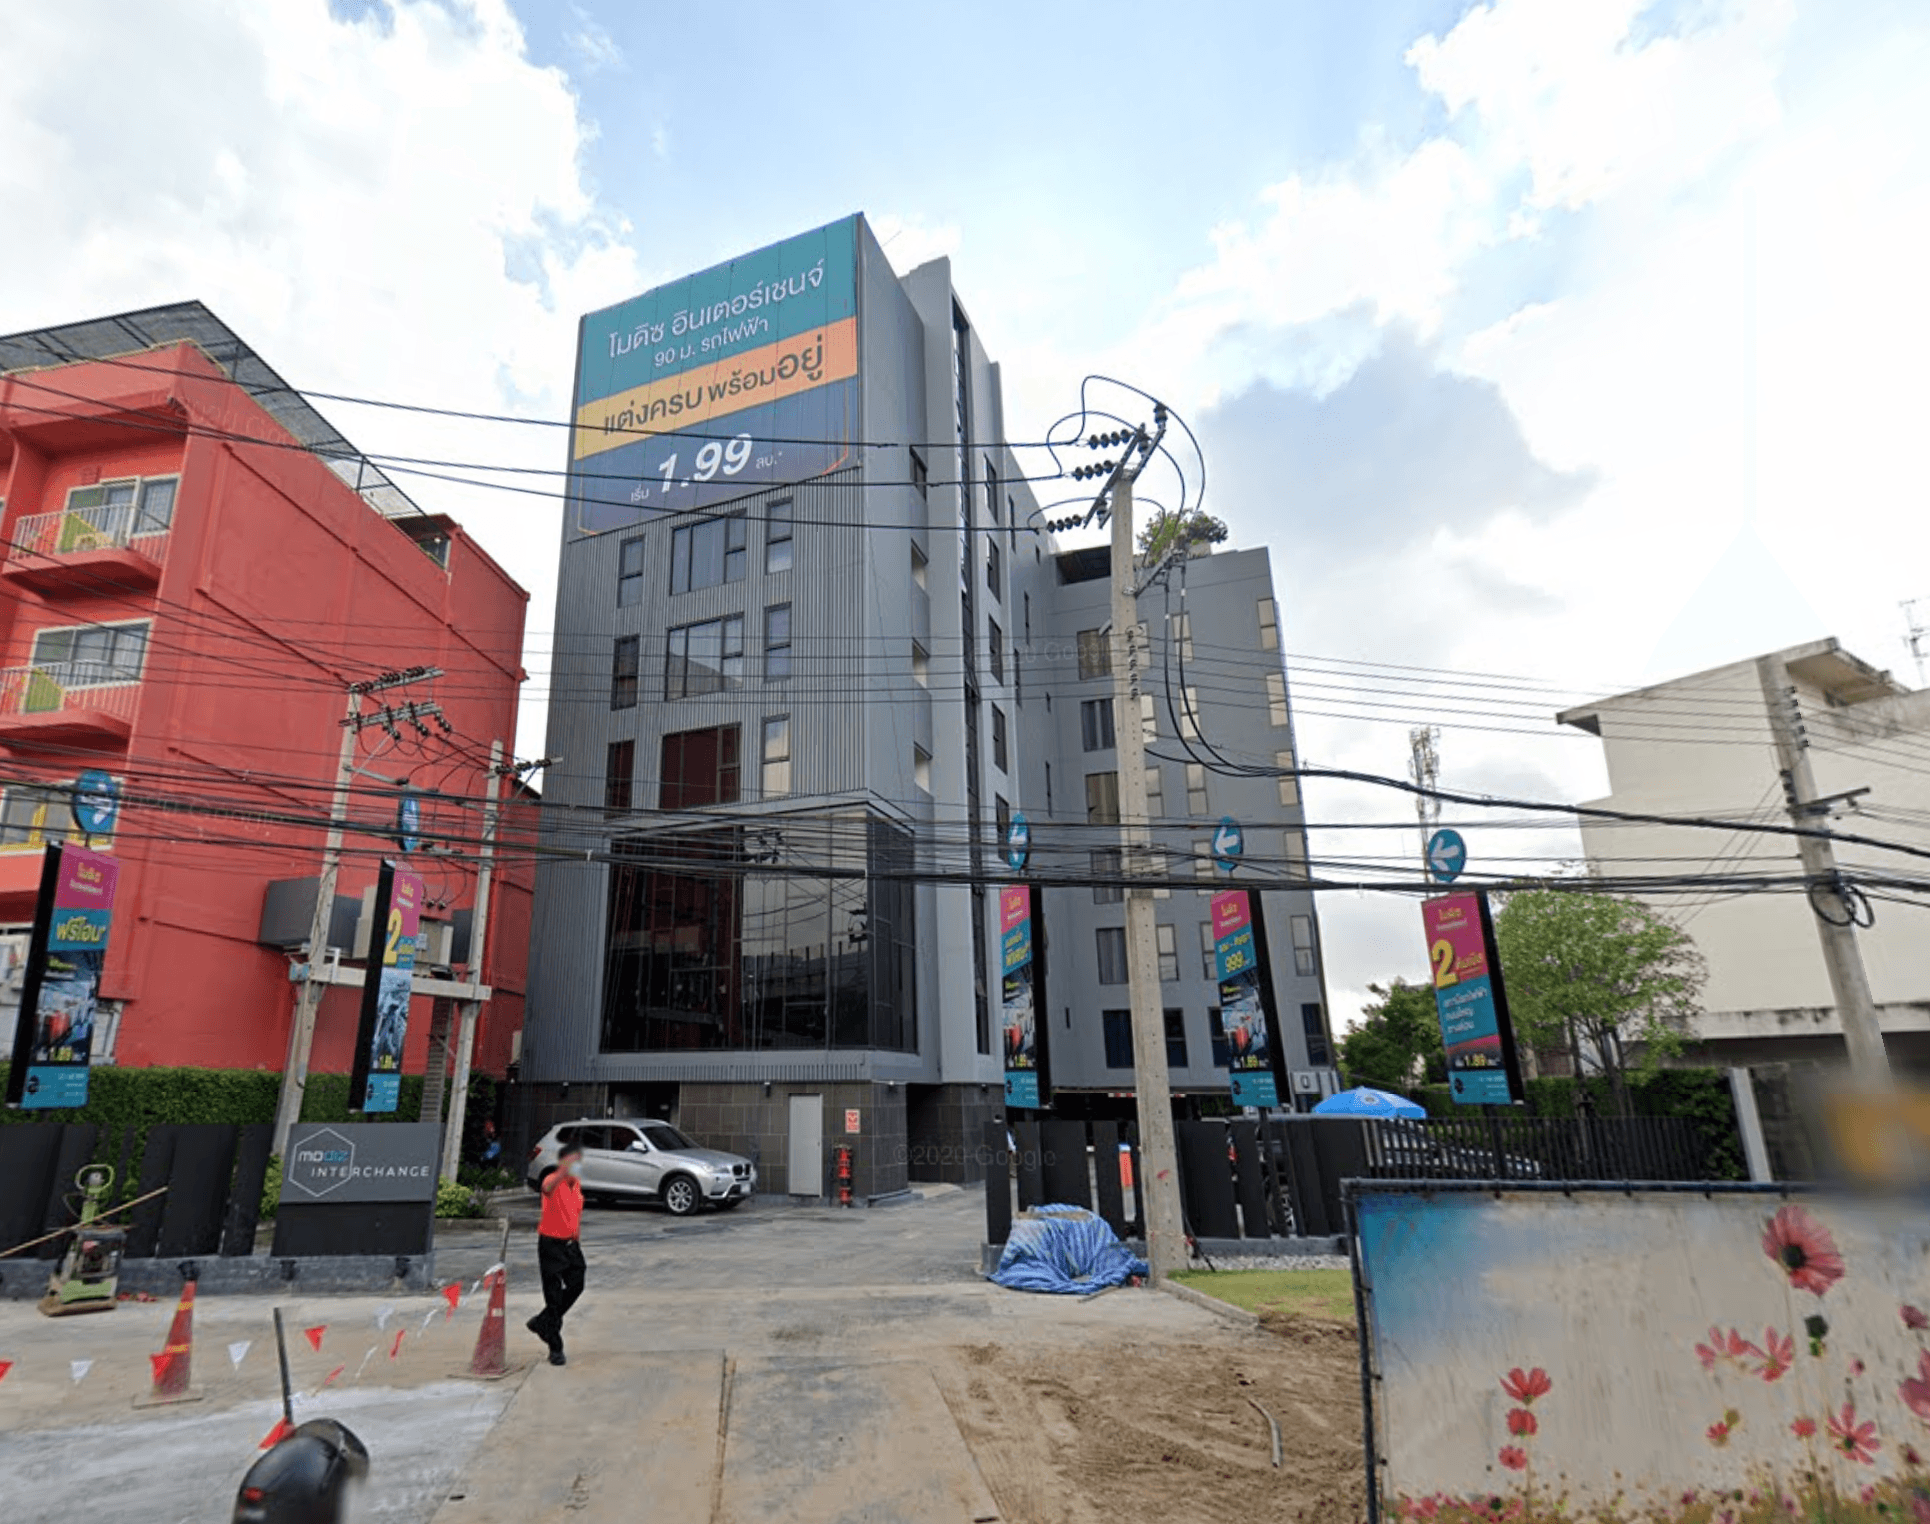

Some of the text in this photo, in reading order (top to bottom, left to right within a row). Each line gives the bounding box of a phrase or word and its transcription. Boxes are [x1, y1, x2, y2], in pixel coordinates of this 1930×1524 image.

[671, 258, 825, 336] อินเตอร์เชนจ์
[654, 346, 676, 368] 90
[701, 315, 769, 353] รถไฟฟ้า
[603, 334, 824, 435] แต่งครบ พร้อมอยู่
[659, 433, 753, 493] 1.99
[383, 908, 402, 965] 2
[1432, 939, 1458, 988] 2
[311, 1165, 430, 1178] INTERCHANGE
